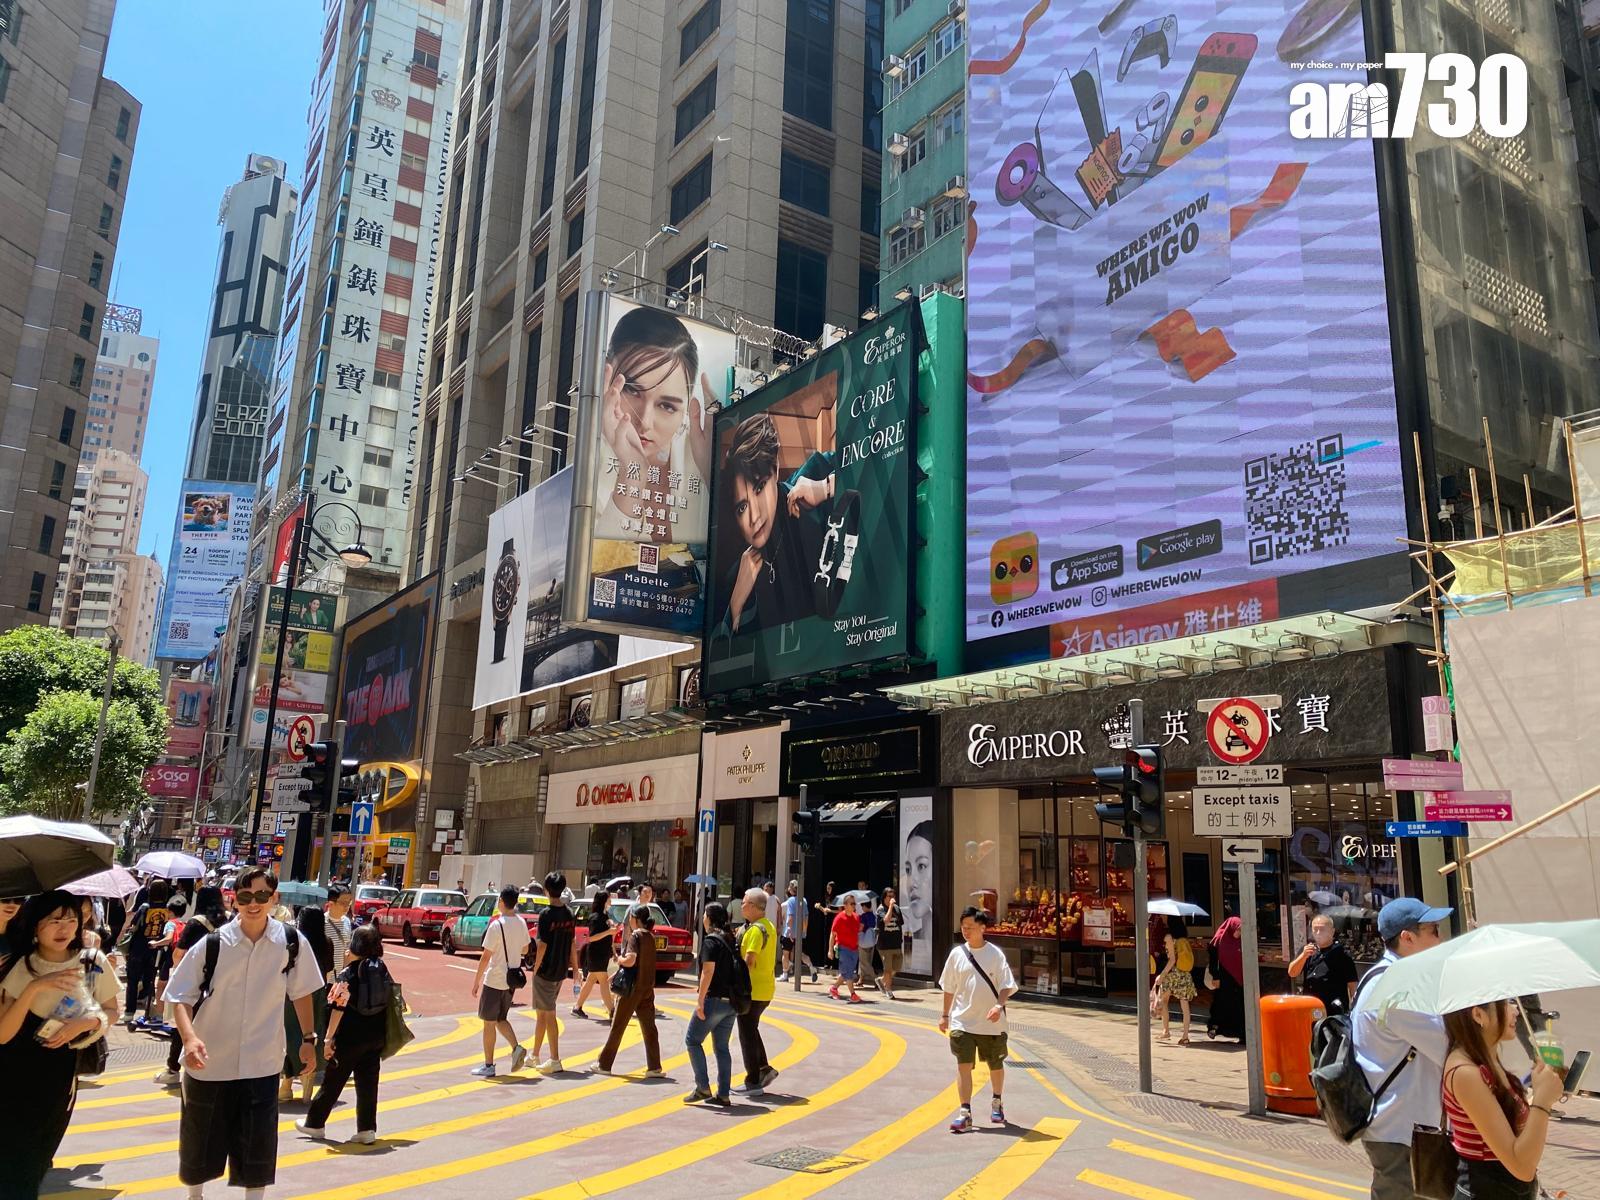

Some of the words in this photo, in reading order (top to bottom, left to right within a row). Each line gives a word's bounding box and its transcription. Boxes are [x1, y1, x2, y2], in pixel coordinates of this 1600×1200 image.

[1095, 233, 1148, 278] WHERE
[1148, 217, 1172, 244] WE
[1172, 191, 1210, 228] WOW
[1105, 222, 1200, 307] AMIGO
[320, 125, 396, 495] 英皇鐘錶珠寶中心
[851, 377, 896, 418] CORE
[868, 415, 877, 430] &
[840, 419, 906, 469] ENCORE
[184, 546, 198, 555] 24
[1159, 537, 1193, 554] Google
[1196, 533, 1216, 548] play
[624, 573, 669, 588] MaBelle
[1071, 566, 1091, 581] App
[1092, 560, 1118, 575] Store
[1111, 569, 1202, 599] WHEREWEWOW
[656, 603, 674, 612] 3925
[675, 606, 693, 615] 0470
[1007, 595, 1083, 622] WHEREWEWOW
[833, 619, 850, 633] Stay
[851, 615, 867, 627] You
[846, 632, 864, 647] Stay
[864, 622, 898, 643] Original
[967, 723, 1087, 768] EMPEROR
[157, 768, 190, 782] Sasa
[1265, 768, 1280, 780] 12
[278, 784, 297, 792] Except
[591, 782, 635, 806] OMEGA
[1204, 794, 1246, 807] Except
[1248, 793, 1280, 805] taxis
[1207, 810, 1277, 828] 的士例外
